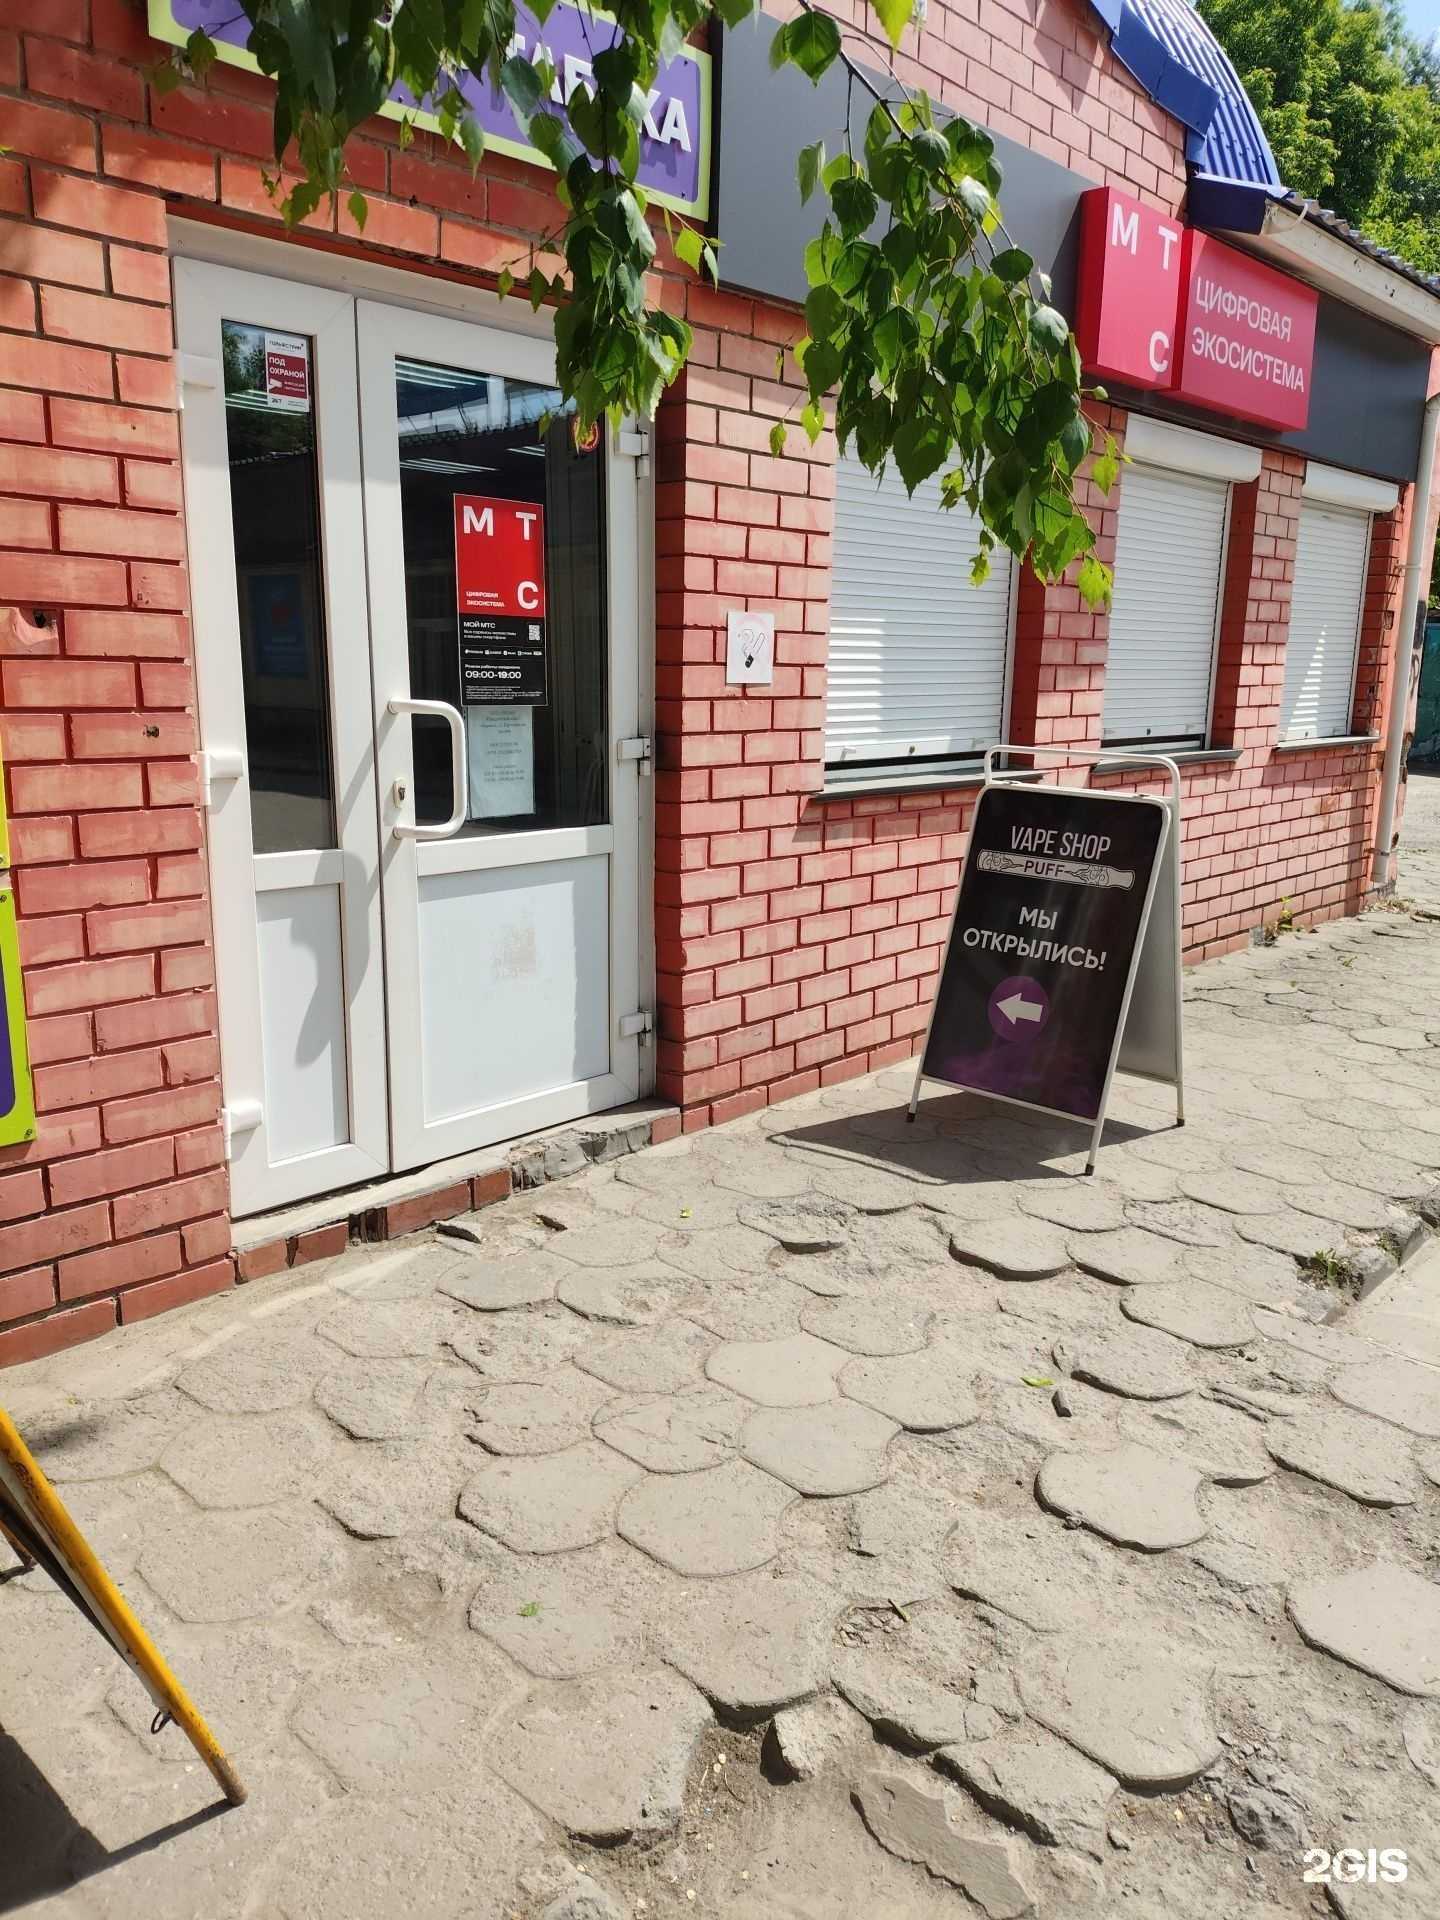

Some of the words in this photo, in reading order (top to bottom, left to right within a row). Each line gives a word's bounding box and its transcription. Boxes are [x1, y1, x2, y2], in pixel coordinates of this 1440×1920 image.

[1195, 276, 1293, 343] ЦИФРОВАЯ
[268, 356, 286, 367] ПОД
[269, 367, 305, 380] ОХРАНОЙ
[1191, 326, 1305, 393] ЭКОСИСТЕМА
[1010, 825, 1059, 854] VAPE
[1059, 831, 1112, 860] SHOP
[1023, 860, 1065, 877] PUFF
[1018, 906, 1058, 930] МЫ
[963, 927, 1107, 971] ОТКРЫЛИСЬ!
